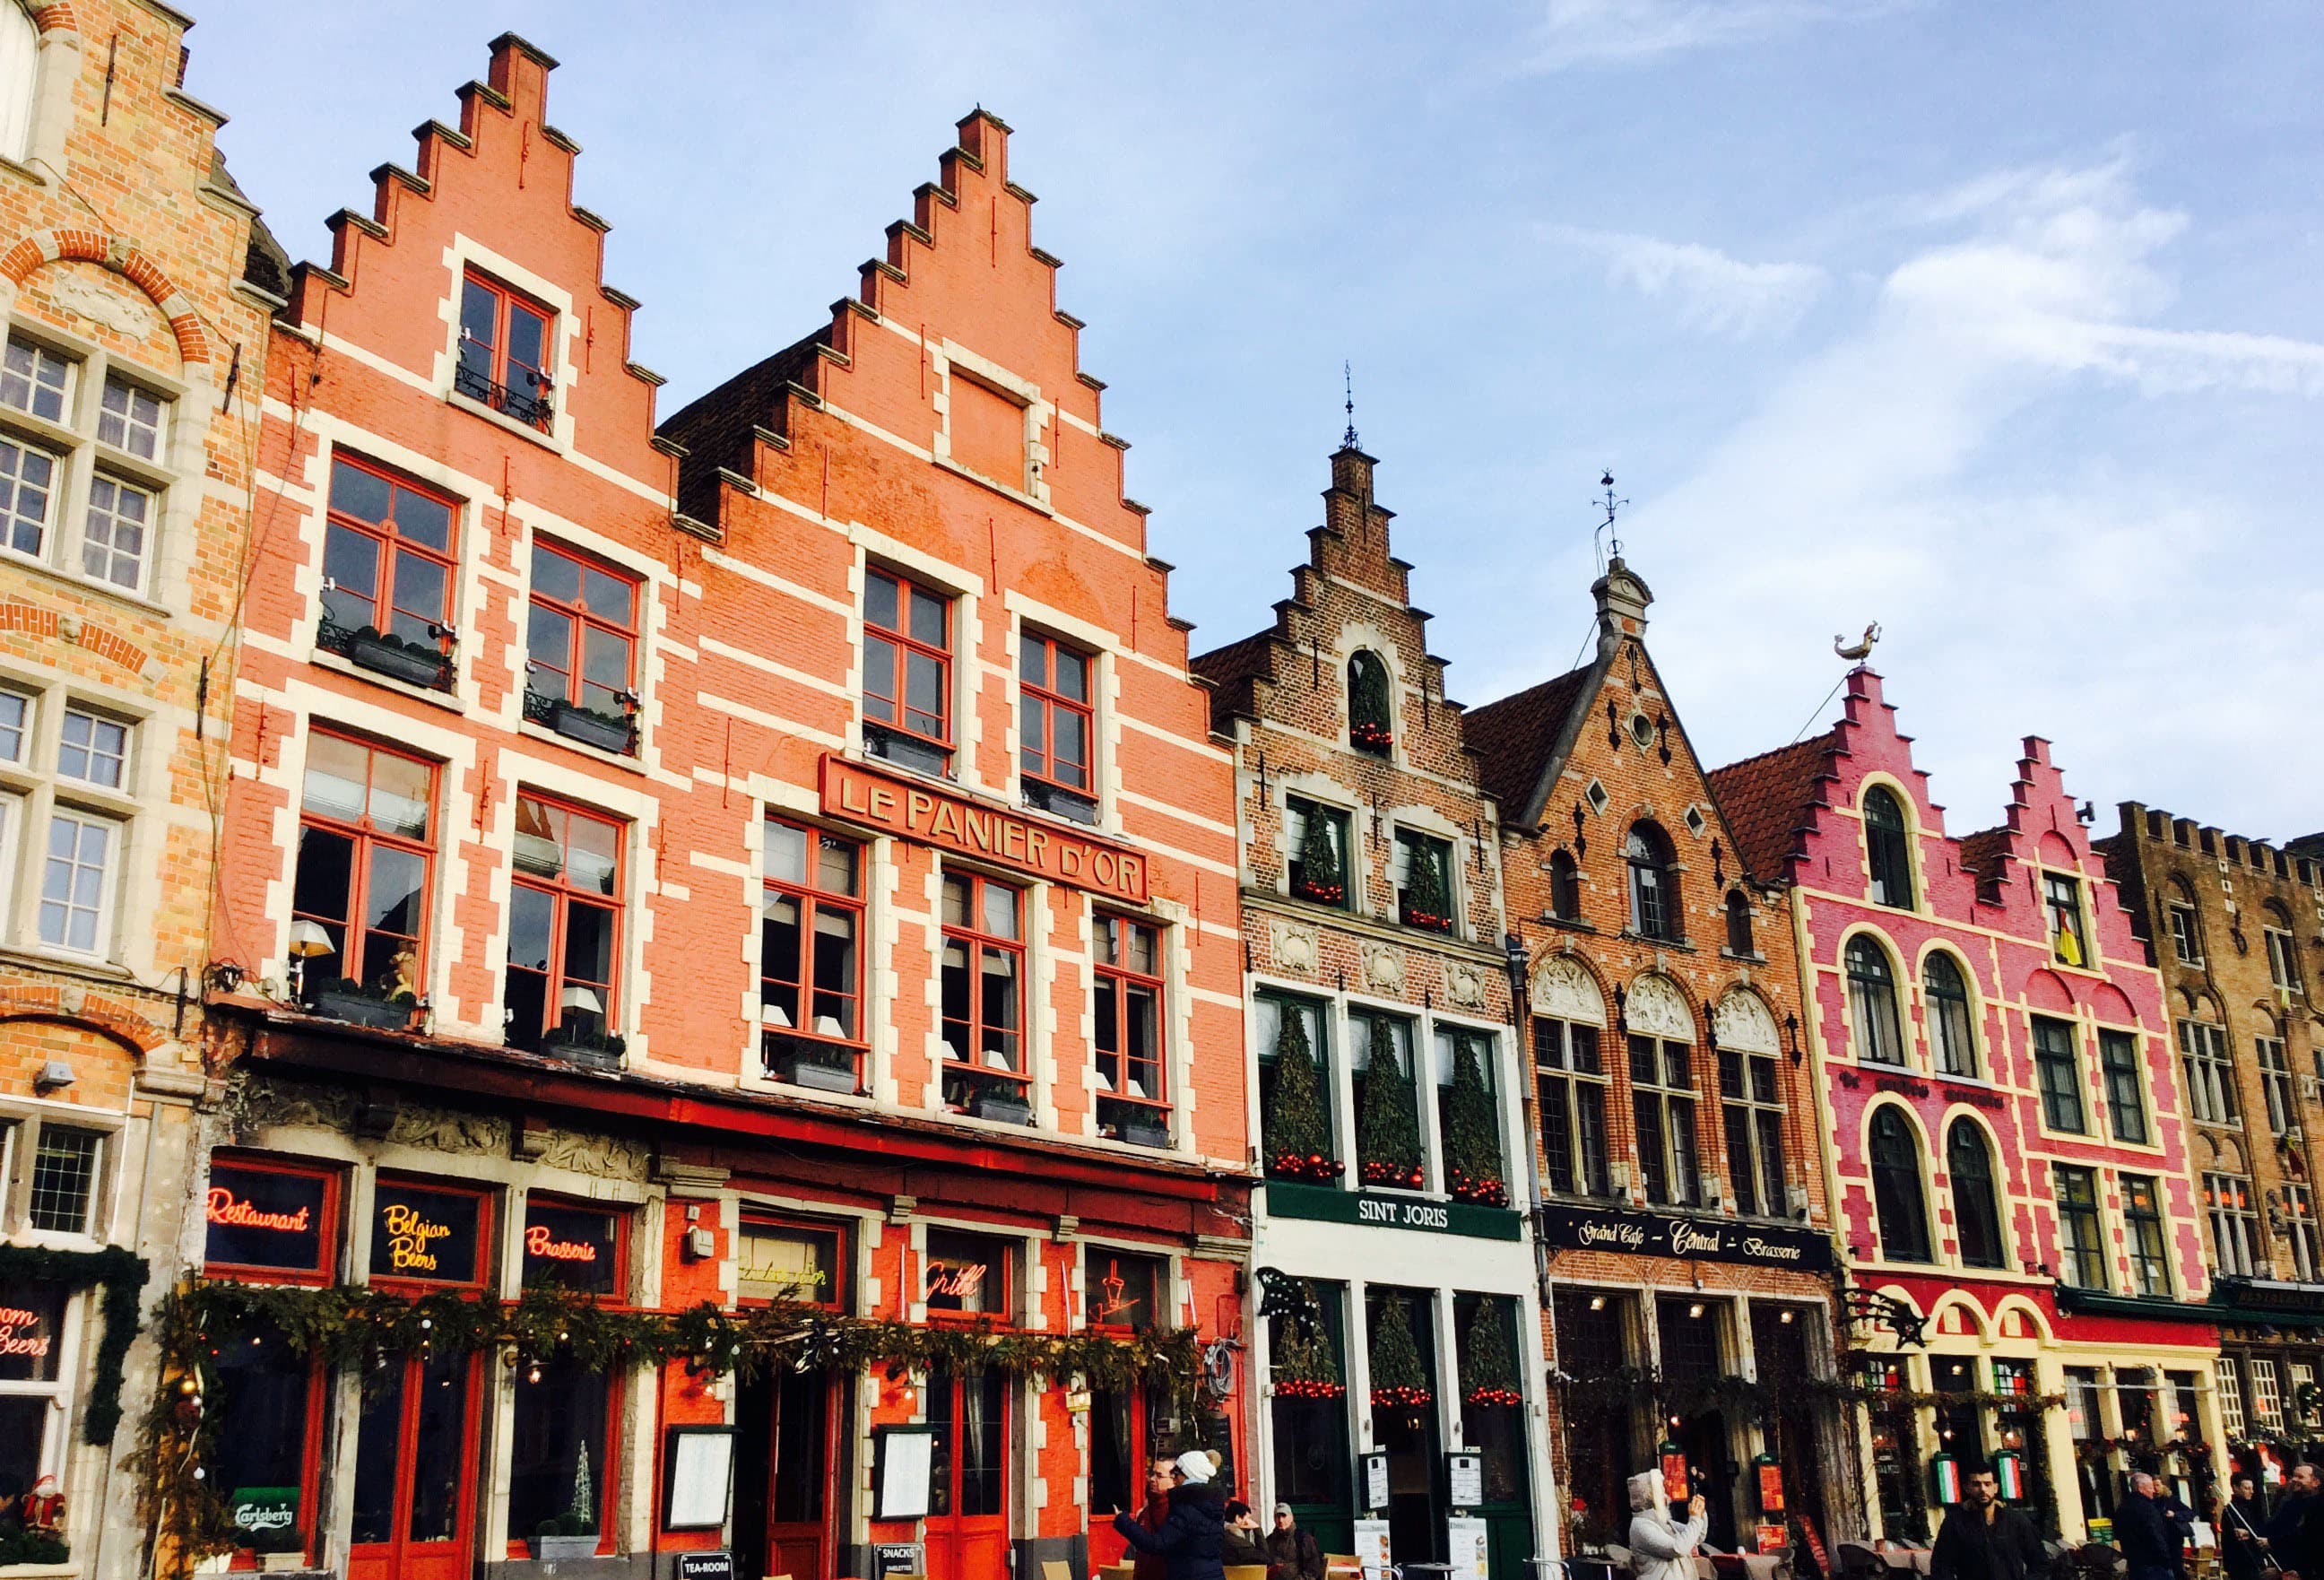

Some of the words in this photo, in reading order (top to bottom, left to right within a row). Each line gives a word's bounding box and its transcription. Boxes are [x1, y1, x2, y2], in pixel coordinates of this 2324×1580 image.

[842, 777, 896, 822] LE
[906, 788, 1050, 868] PANIER
[1061, 844, 1140, 895] D'OR
[207, 1187, 309, 1231] Restaurant
[1358, 1200, 1397, 1222] SINT
[1402, 1205, 1448, 1228] JORIS
[383, 1204, 451, 1253] Belgian
[524, 1226, 595, 1261] Brasserie
[1579, 1220, 1617, 1245] Grand
[1669, 1220, 1720, 1254] Central
[1742, 1237, 1800, 1260] Brasserie
[388, 1237, 438, 1270] Beers
[235, 1503, 293, 1532] Carlsberg
[684, 1561, 729, 1574] TEA-ROOM
[882, 1548, 915, 1558] SNACKS
